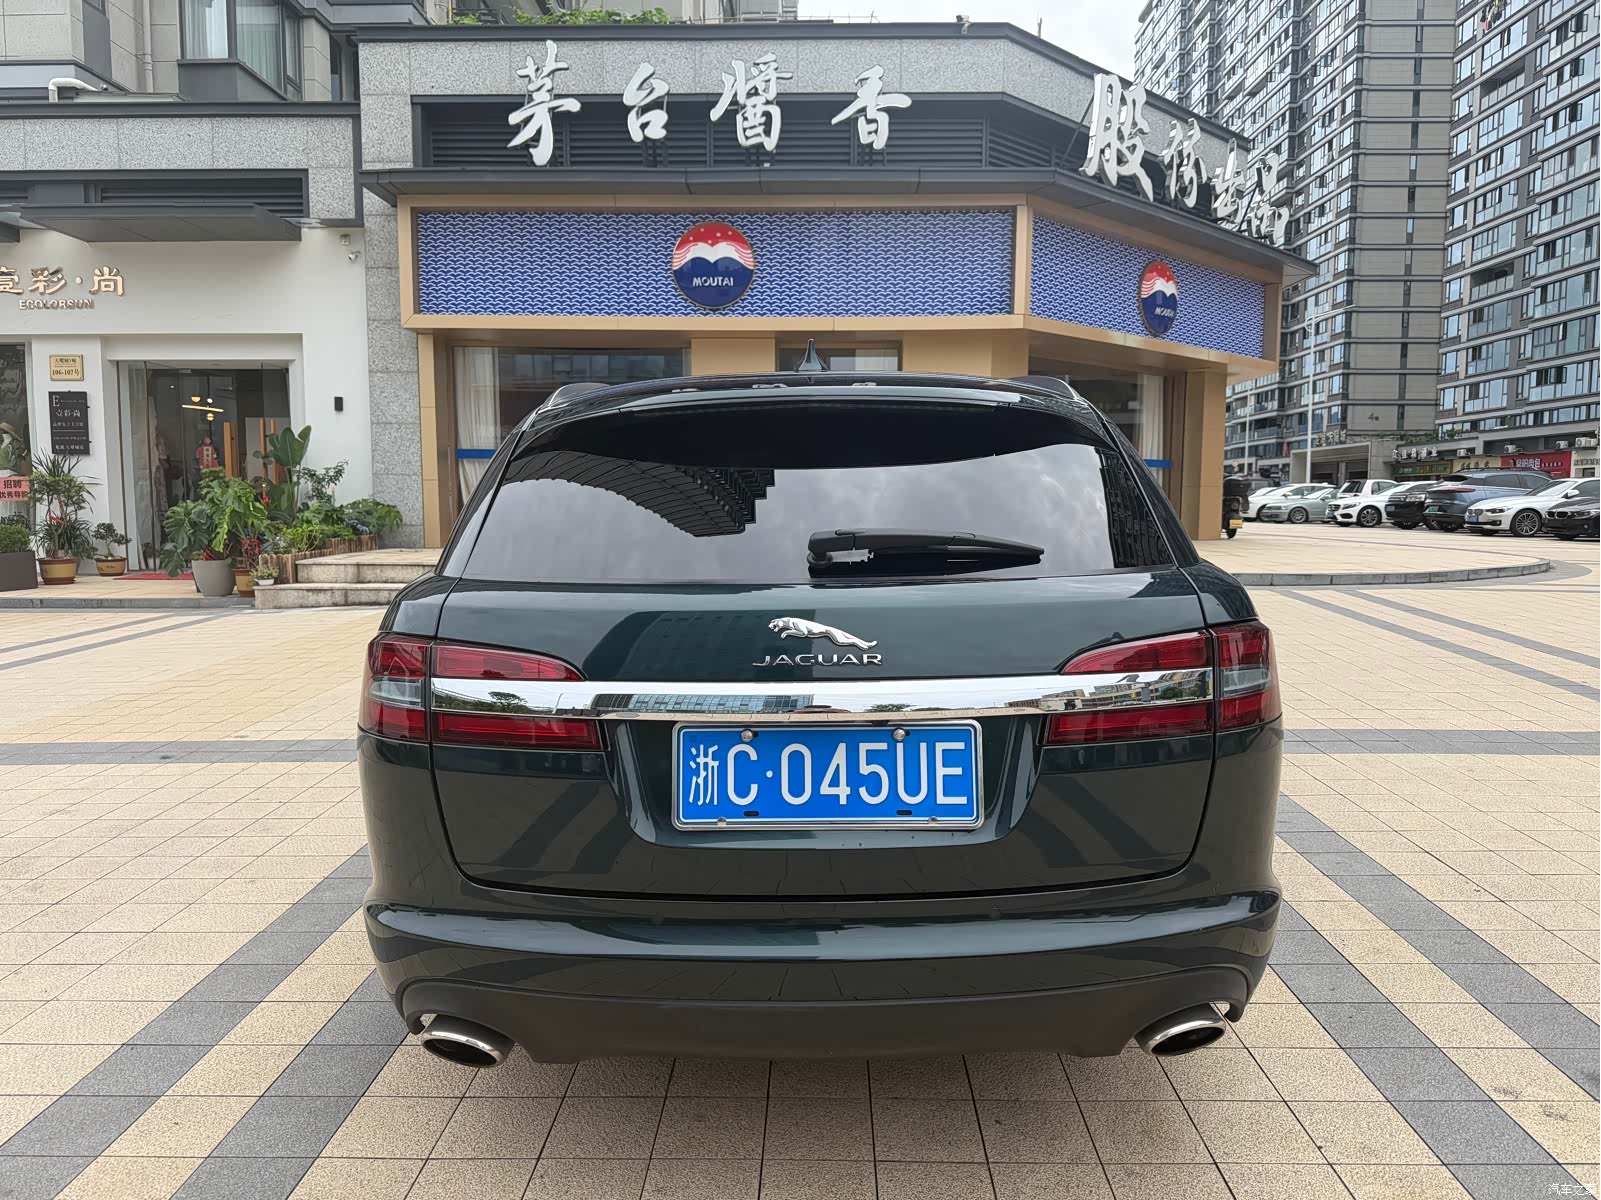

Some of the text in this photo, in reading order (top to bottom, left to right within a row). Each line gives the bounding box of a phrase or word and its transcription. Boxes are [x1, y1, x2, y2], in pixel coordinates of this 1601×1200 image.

[693, 277, 734, 287] MOUTAI
[19, 299, 94, 310] ECOLORSUN
[52, 395, 60, 407] E
[4, 480, 22, 489] 招聘
[752, 653, 883, 666] JAGUAR
[688, 742, 968, 806] 浙C·045UE
